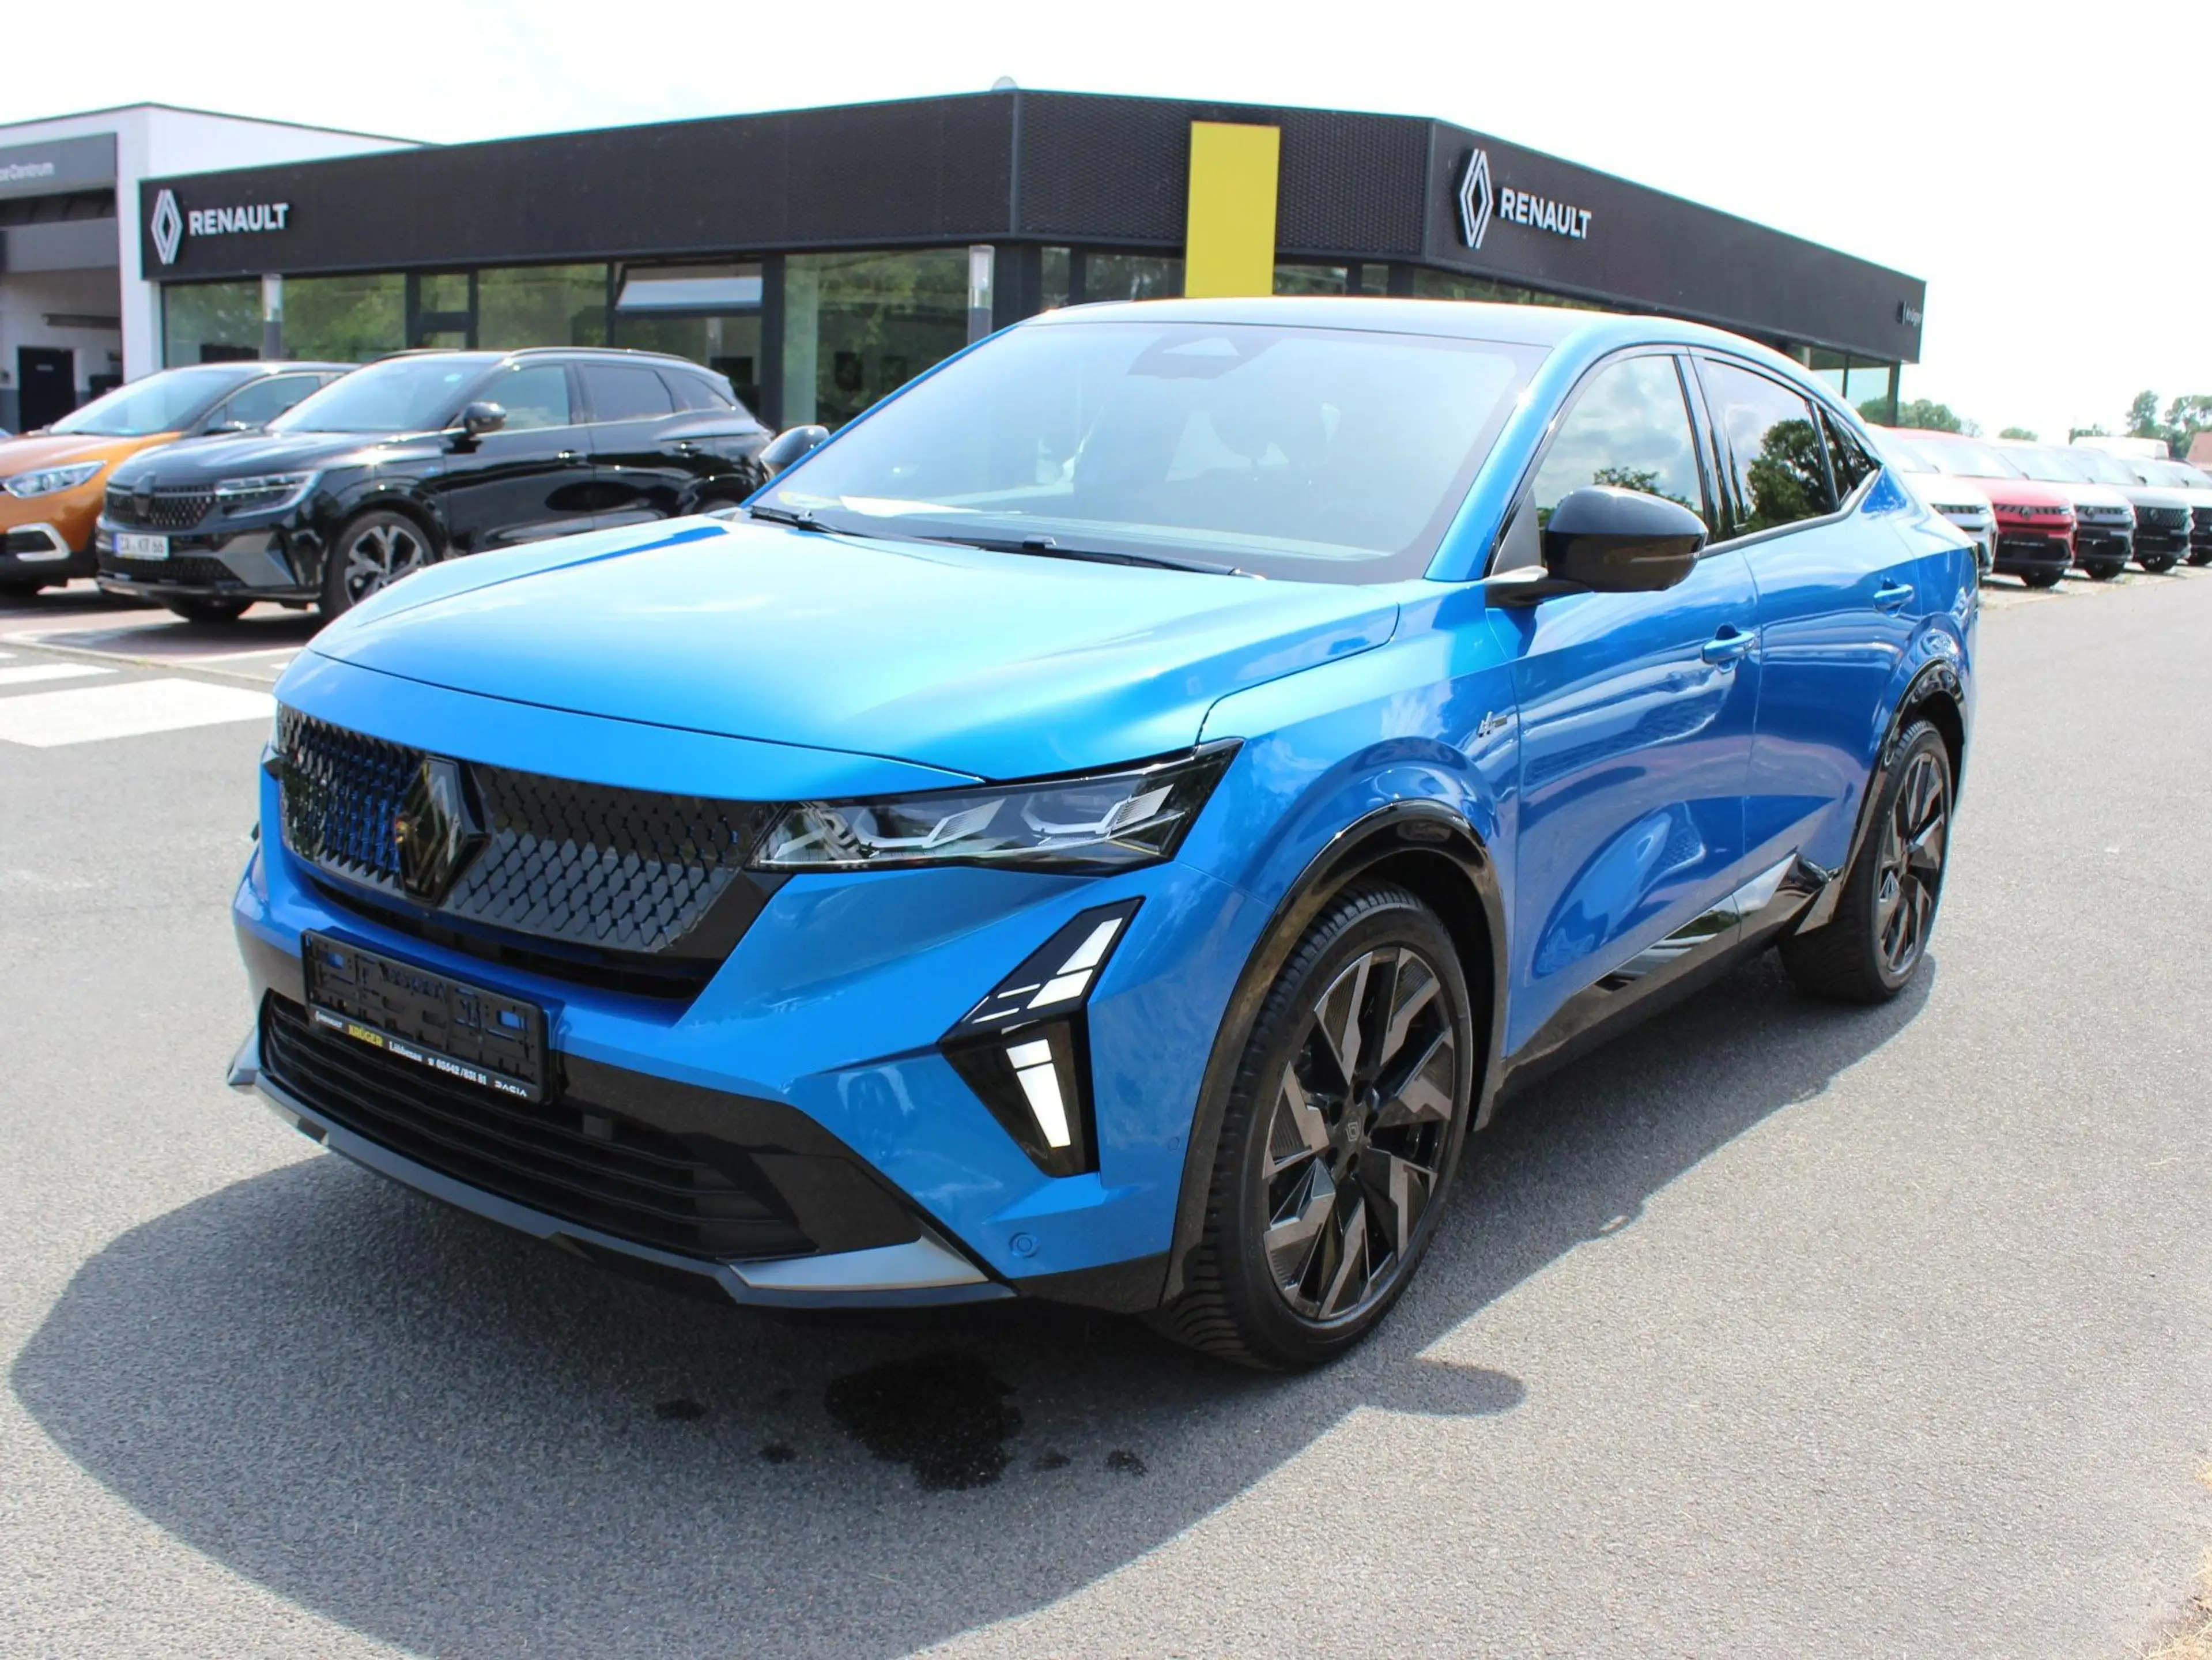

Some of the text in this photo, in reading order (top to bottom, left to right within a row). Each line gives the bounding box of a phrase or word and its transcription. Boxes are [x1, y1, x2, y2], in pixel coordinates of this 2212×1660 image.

[188, 202, 289, 237] RENAULT
[1500, 186, 1592, 240] RENAULT
[494, 1080, 527, 1098] DACIA
